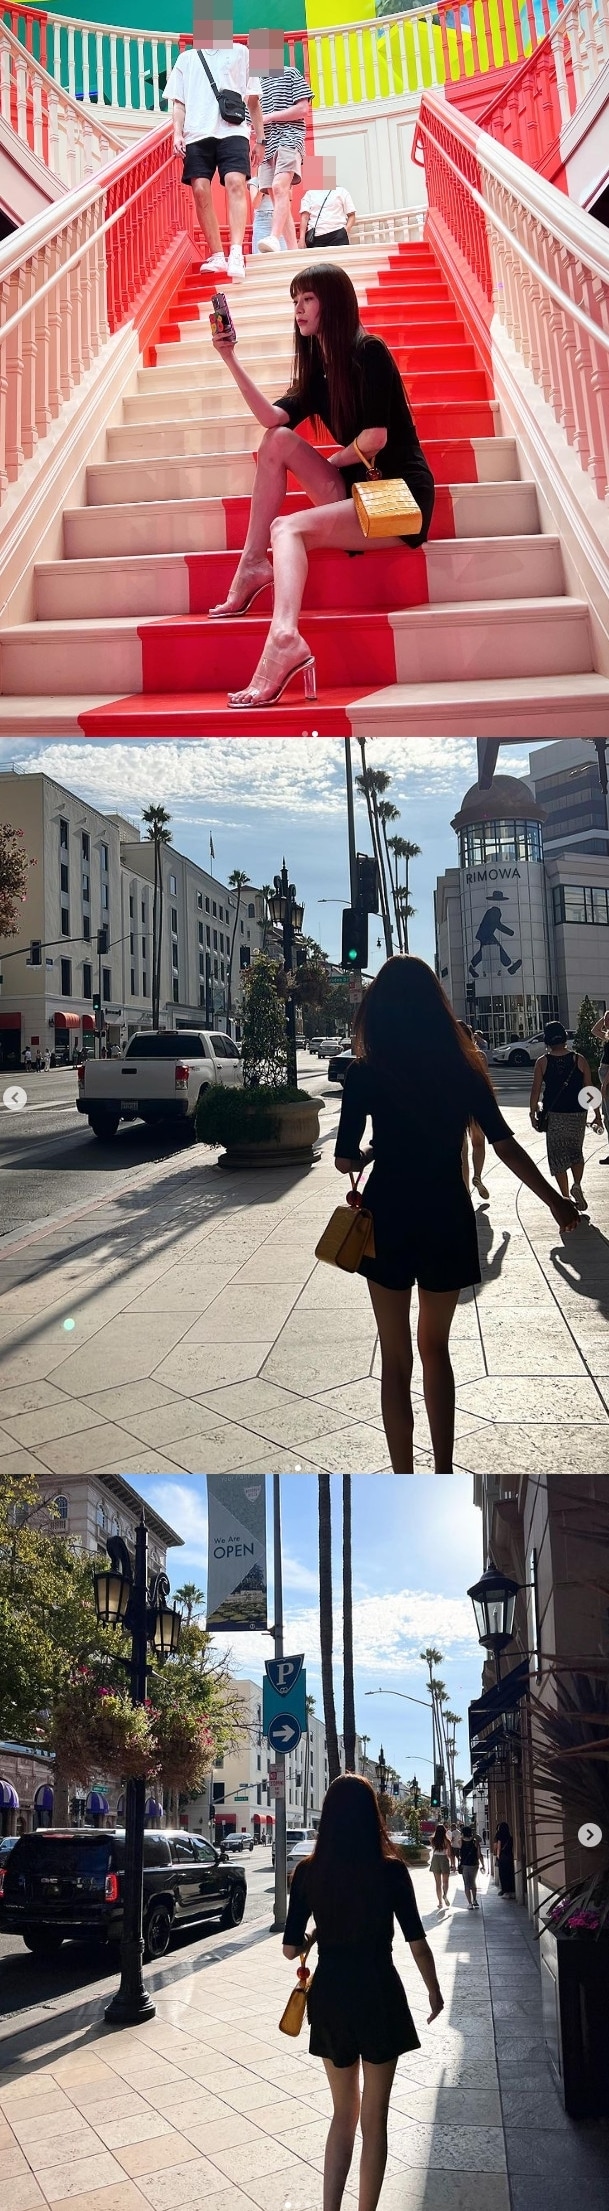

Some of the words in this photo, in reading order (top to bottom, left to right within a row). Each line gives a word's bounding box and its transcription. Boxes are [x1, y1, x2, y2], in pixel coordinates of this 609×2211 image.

[466, 868, 521, 884] RIMOWA
[213, 1542, 254, 1559] OPEN
[276, 1662, 294, 1686] P
